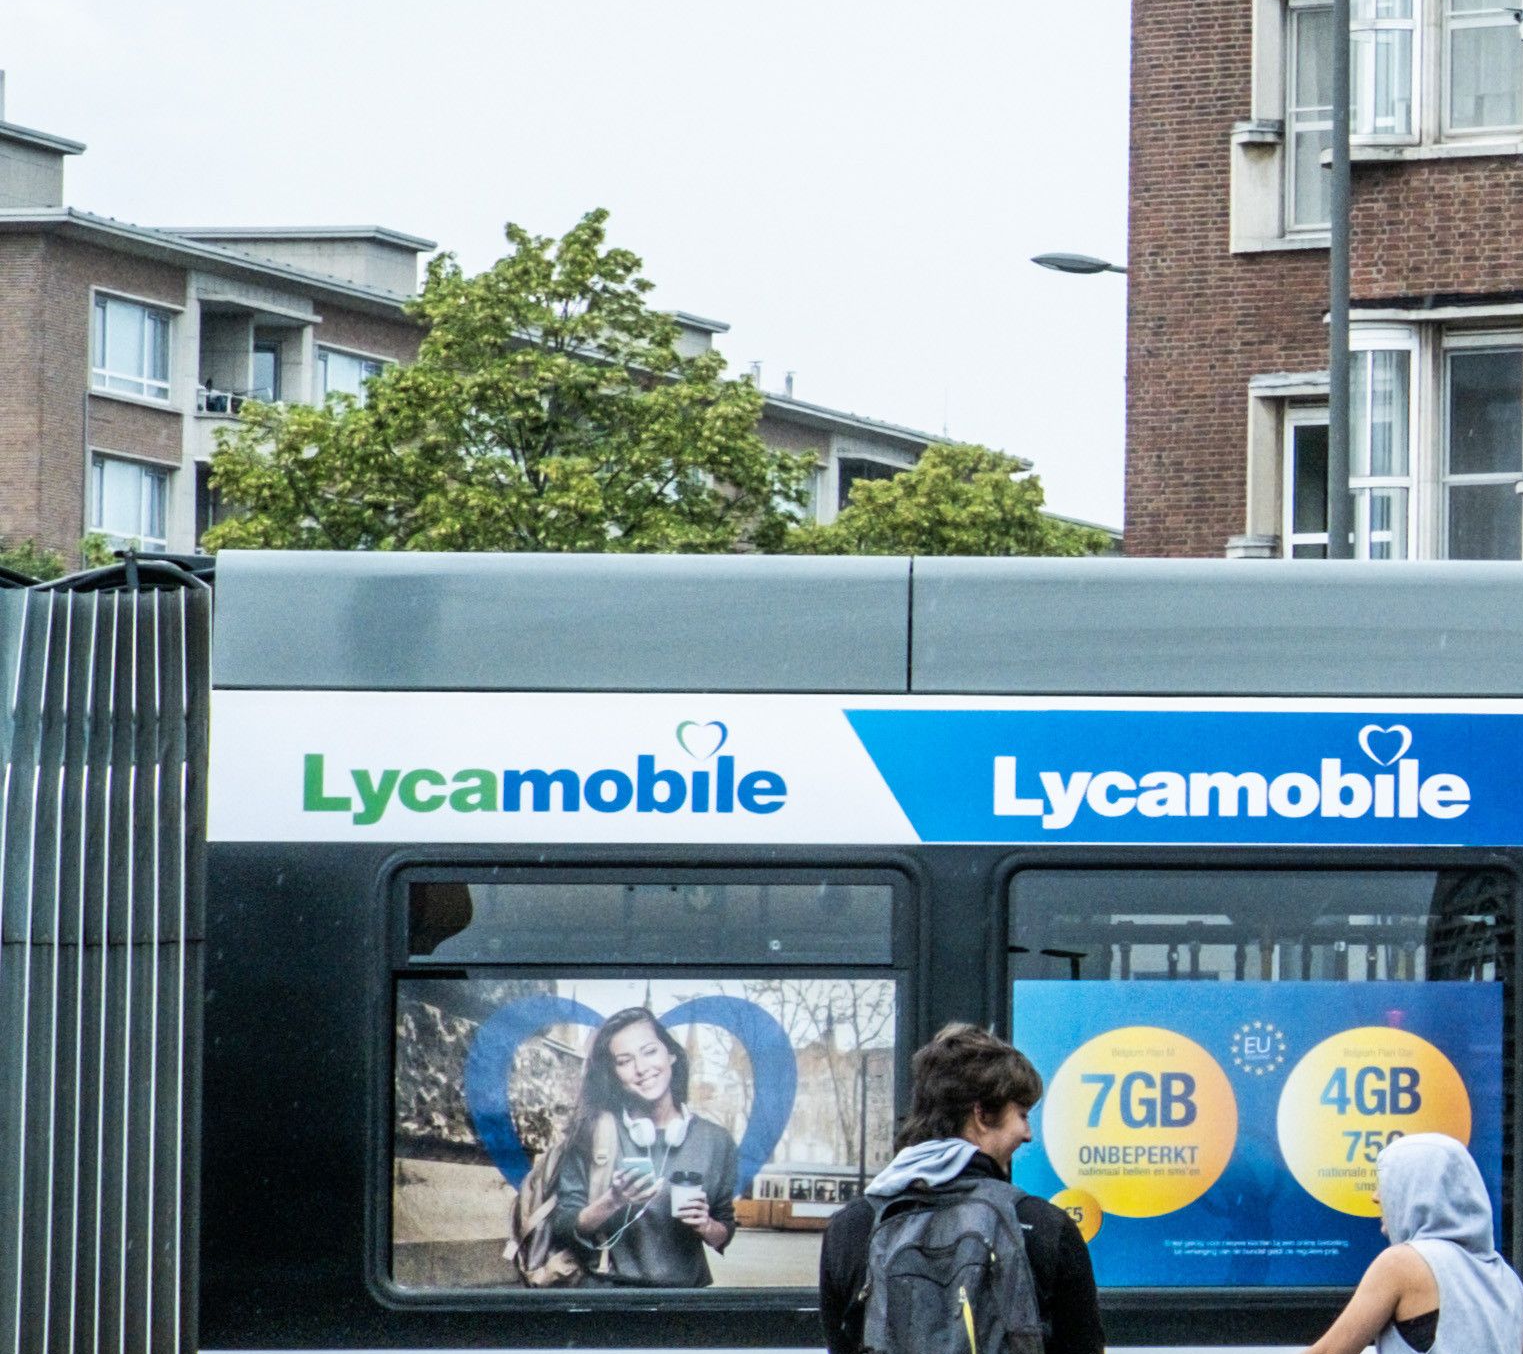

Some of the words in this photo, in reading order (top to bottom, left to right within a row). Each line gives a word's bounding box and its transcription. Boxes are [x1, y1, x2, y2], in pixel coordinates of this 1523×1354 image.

[302, 752, 788, 826] Lycamobile
[993, 754, 1473, 831] Lycamobile
[1244, 1035, 1271, 1054] EU
[1080, 1070, 1198, 1129] 7GB
[1319, 1065, 1422, 1117] 4GB
[1078, 1145, 1199, 1165] ONBEPERKT
[1317, 1166, 1367, 1178] nationale
